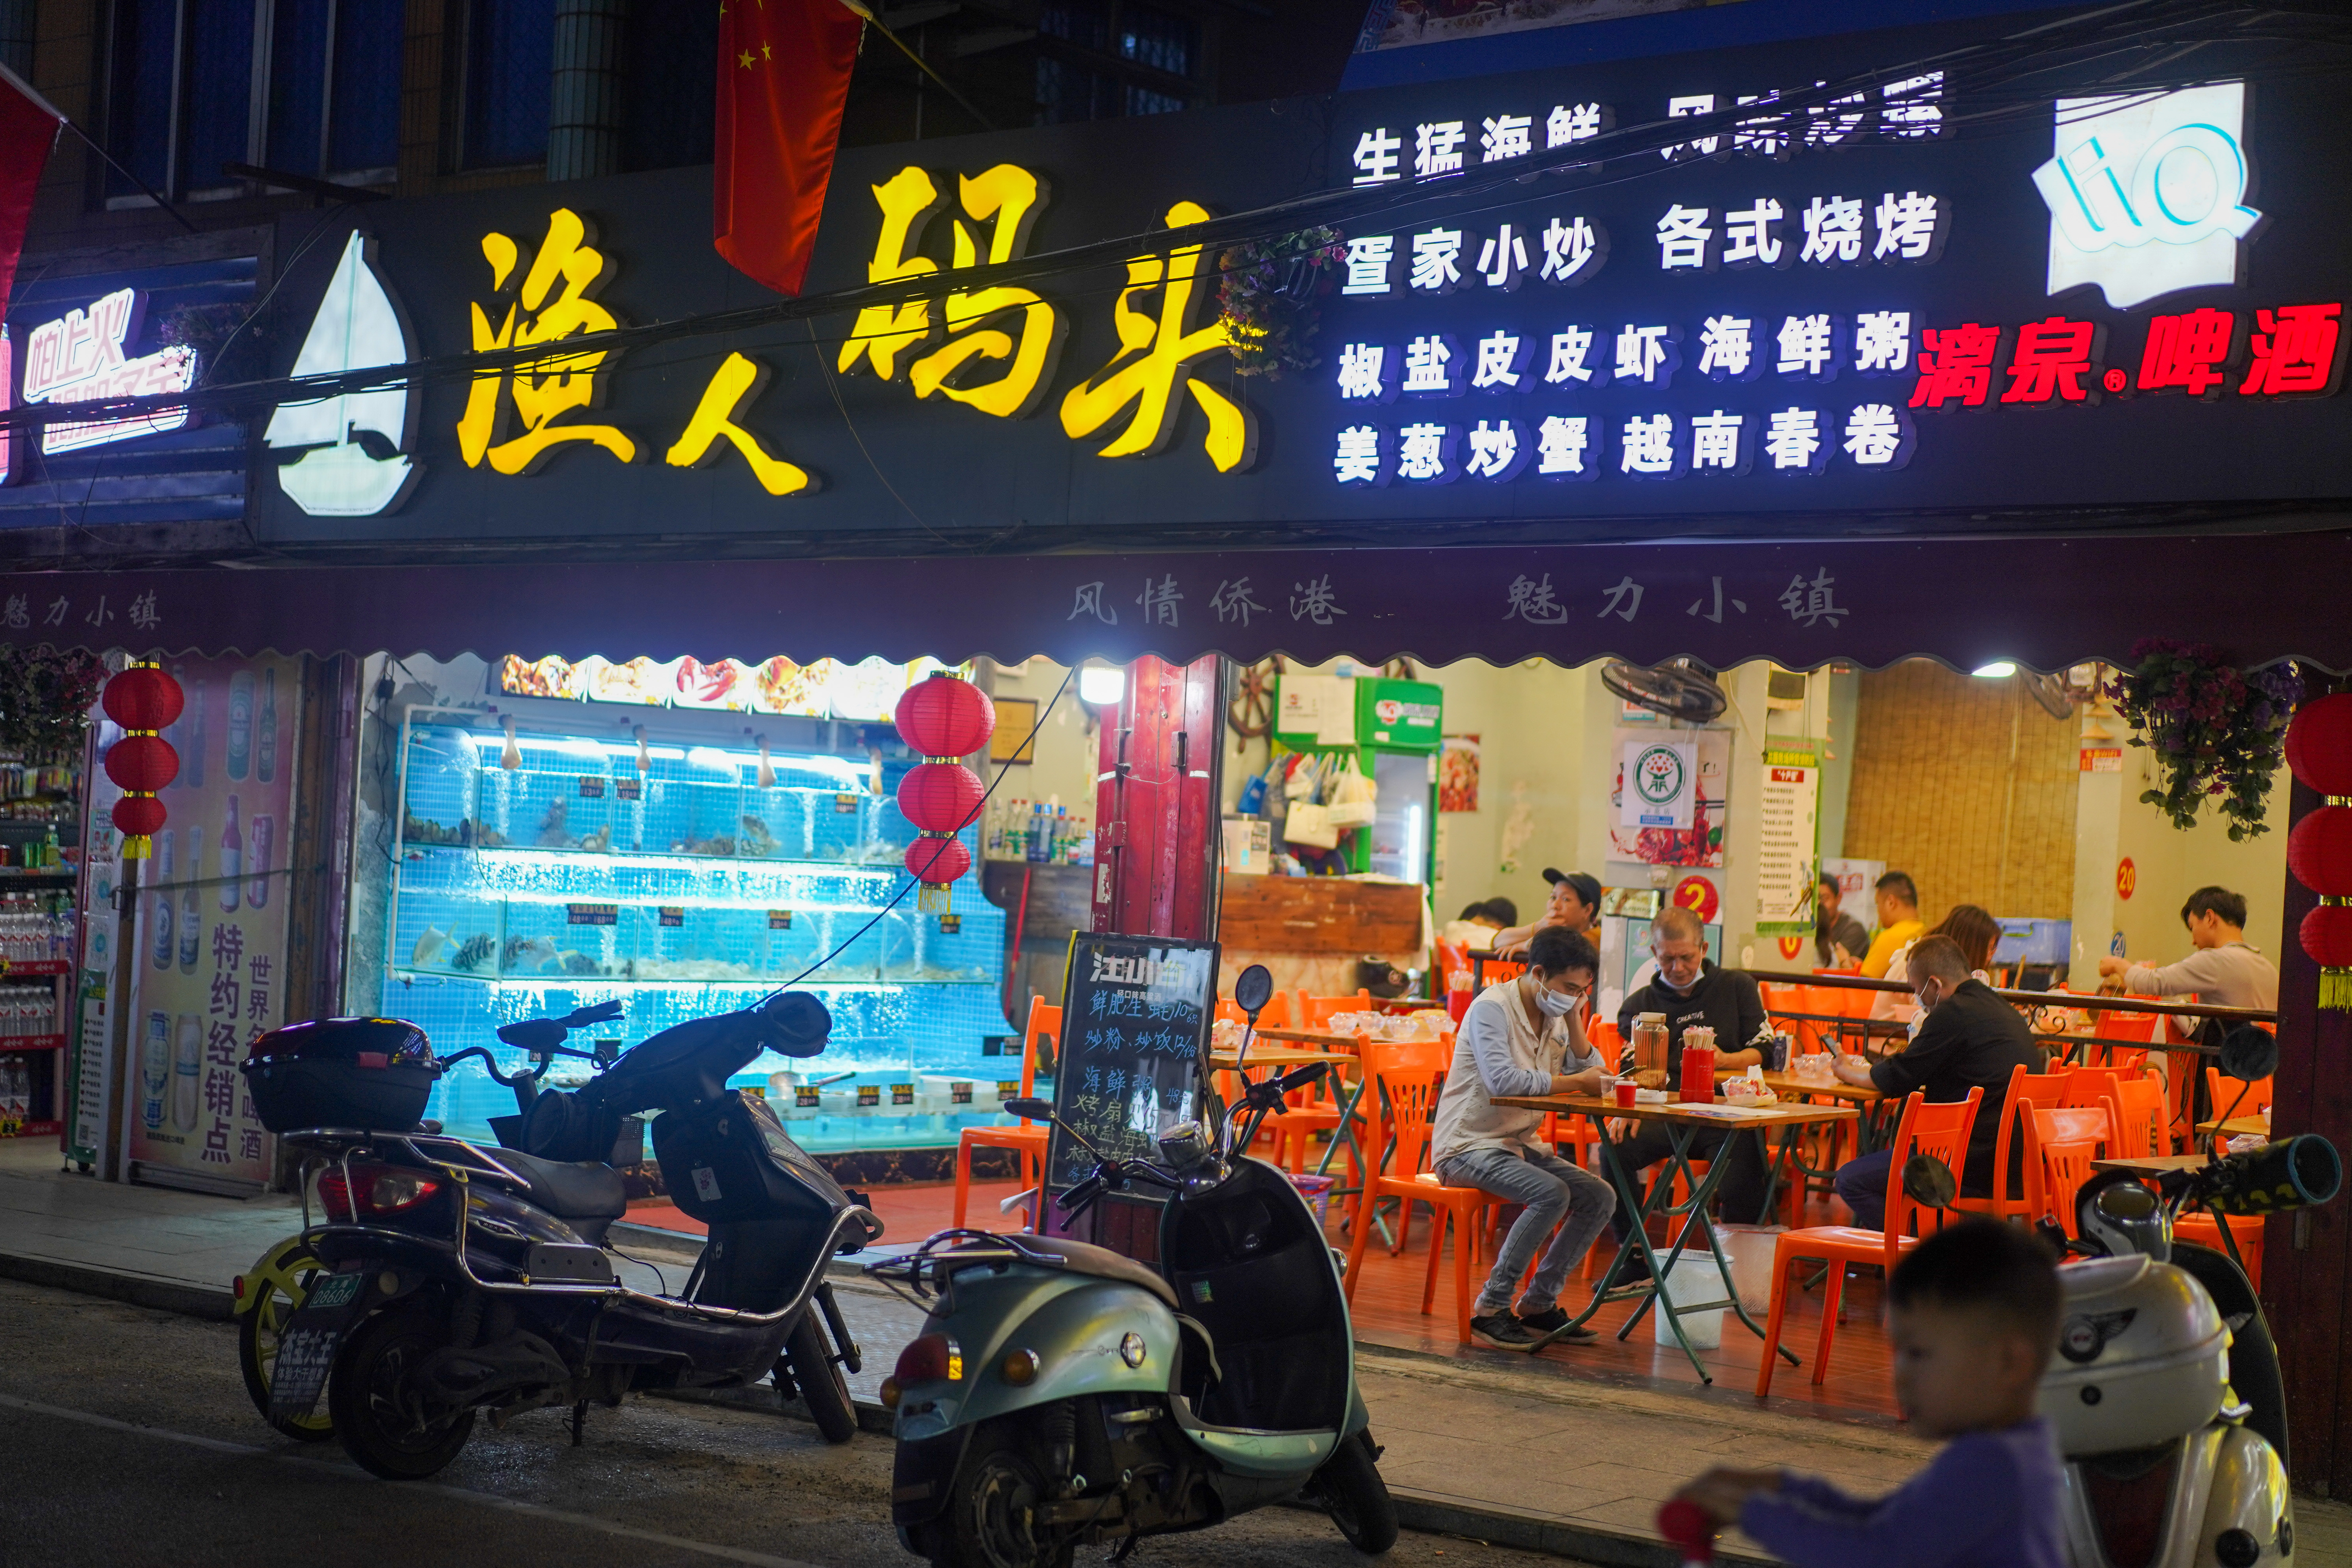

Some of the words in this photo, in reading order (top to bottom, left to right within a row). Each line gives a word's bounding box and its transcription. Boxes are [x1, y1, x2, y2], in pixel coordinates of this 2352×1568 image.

[1352, 102, 1601, 189] 生猛海鲜
[1656, 191, 1938, 270] 各式烧烤
[29, 299, 125, 391] 怕上火
[457, 163, 1268, 497] 渔人码头
[1338, 324, 1667, 399] 椒盐皮皮虾
[1698, 311, 1910, 374] 海鲜粥
[1334, 416, 1587, 483] 姜葱炒蟹
[1621, 404, 1900, 473] 越南春卷
[1, 589, 161, 630] 魅力小镇
[1066, 573, 1348, 628] 风情侨港
[1504, 567, 1849, 630] 魅力小镇
[1685, 883, 1705, 920] 2
[2119, 867, 2135, 893] 20
[201, 922, 243, 1164] 特约经销点
[1677, 1010, 1705, 1024] CREATIVE
[314, 1289, 352, 1304] 08606
